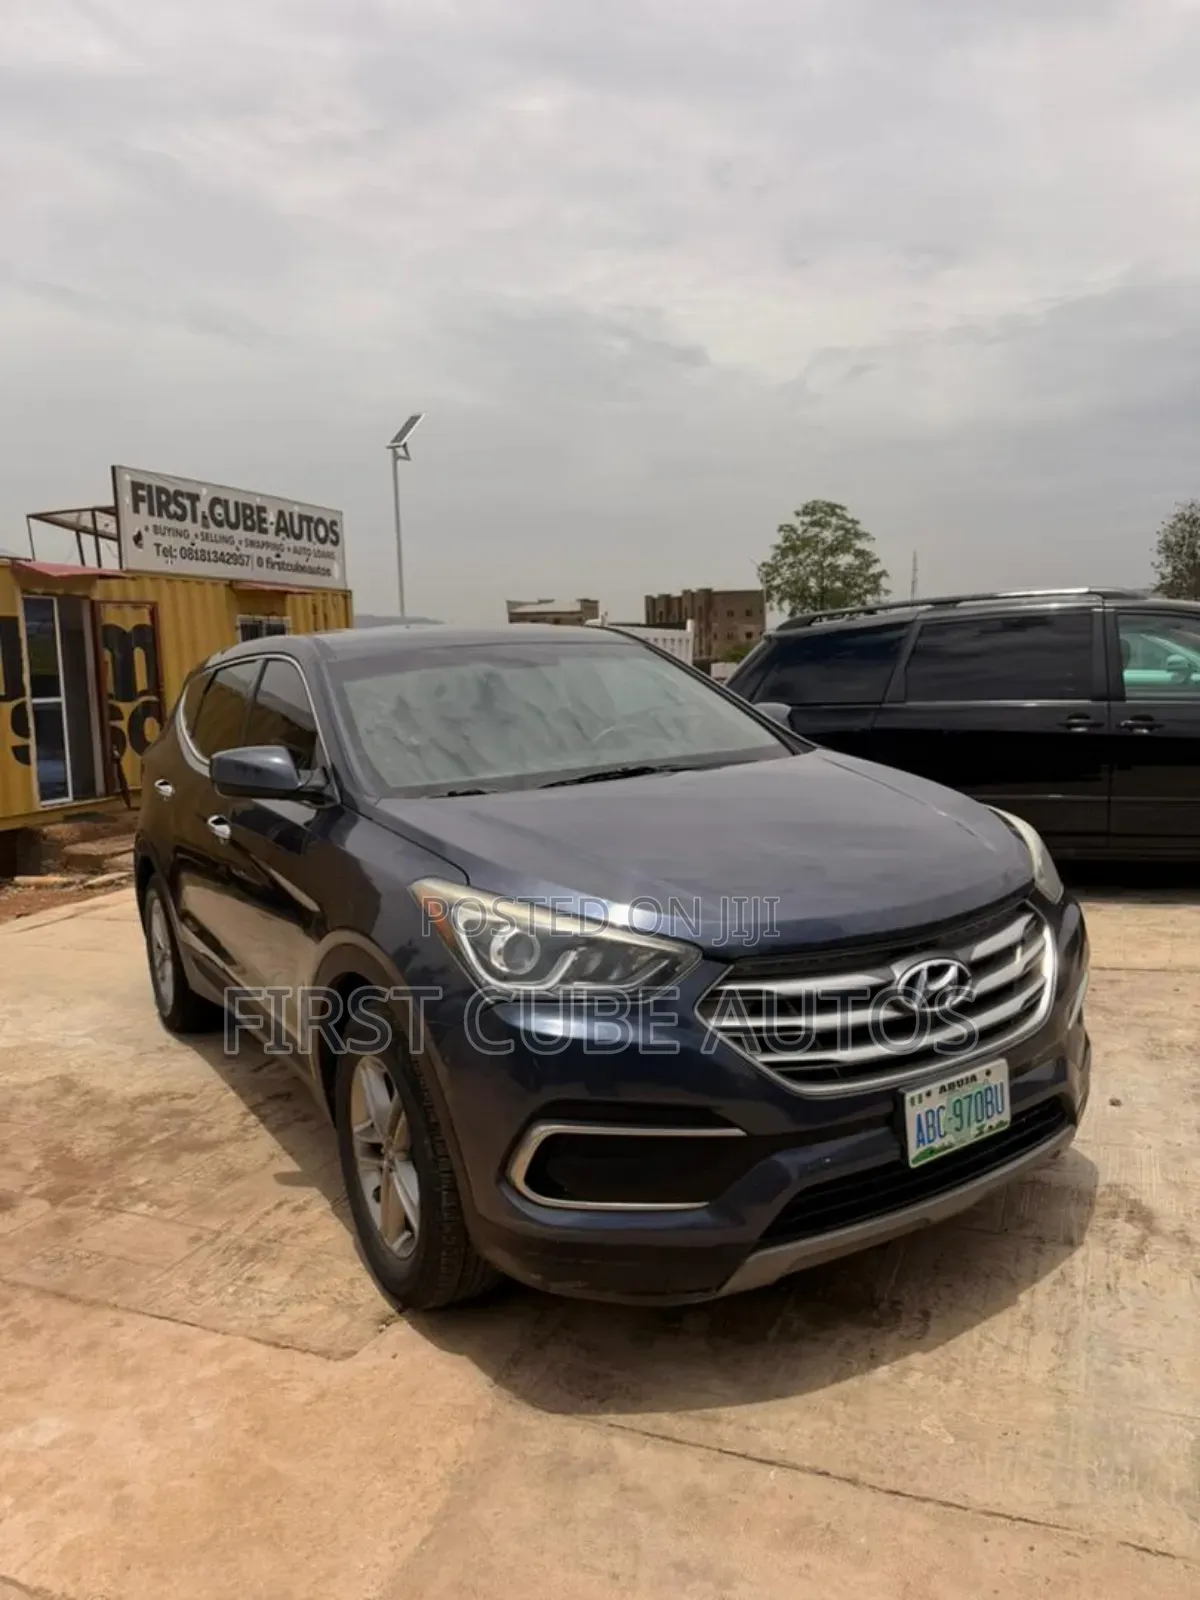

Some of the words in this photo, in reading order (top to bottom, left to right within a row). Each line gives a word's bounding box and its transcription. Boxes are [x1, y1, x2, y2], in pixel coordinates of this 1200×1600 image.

[131, 481, 201, 525] FIRST
[207, 496, 269, 535] CUBE
[275, 509, 340, 547] AUTOS
[153, 524, 190, 540] BUYING
[200, 531, 236, 546] SELLING
[244, 538, 285, 553] SWAPPING
[292, 545, 312, 558] AUTO
[154, 543, 178, 559] Tel:
